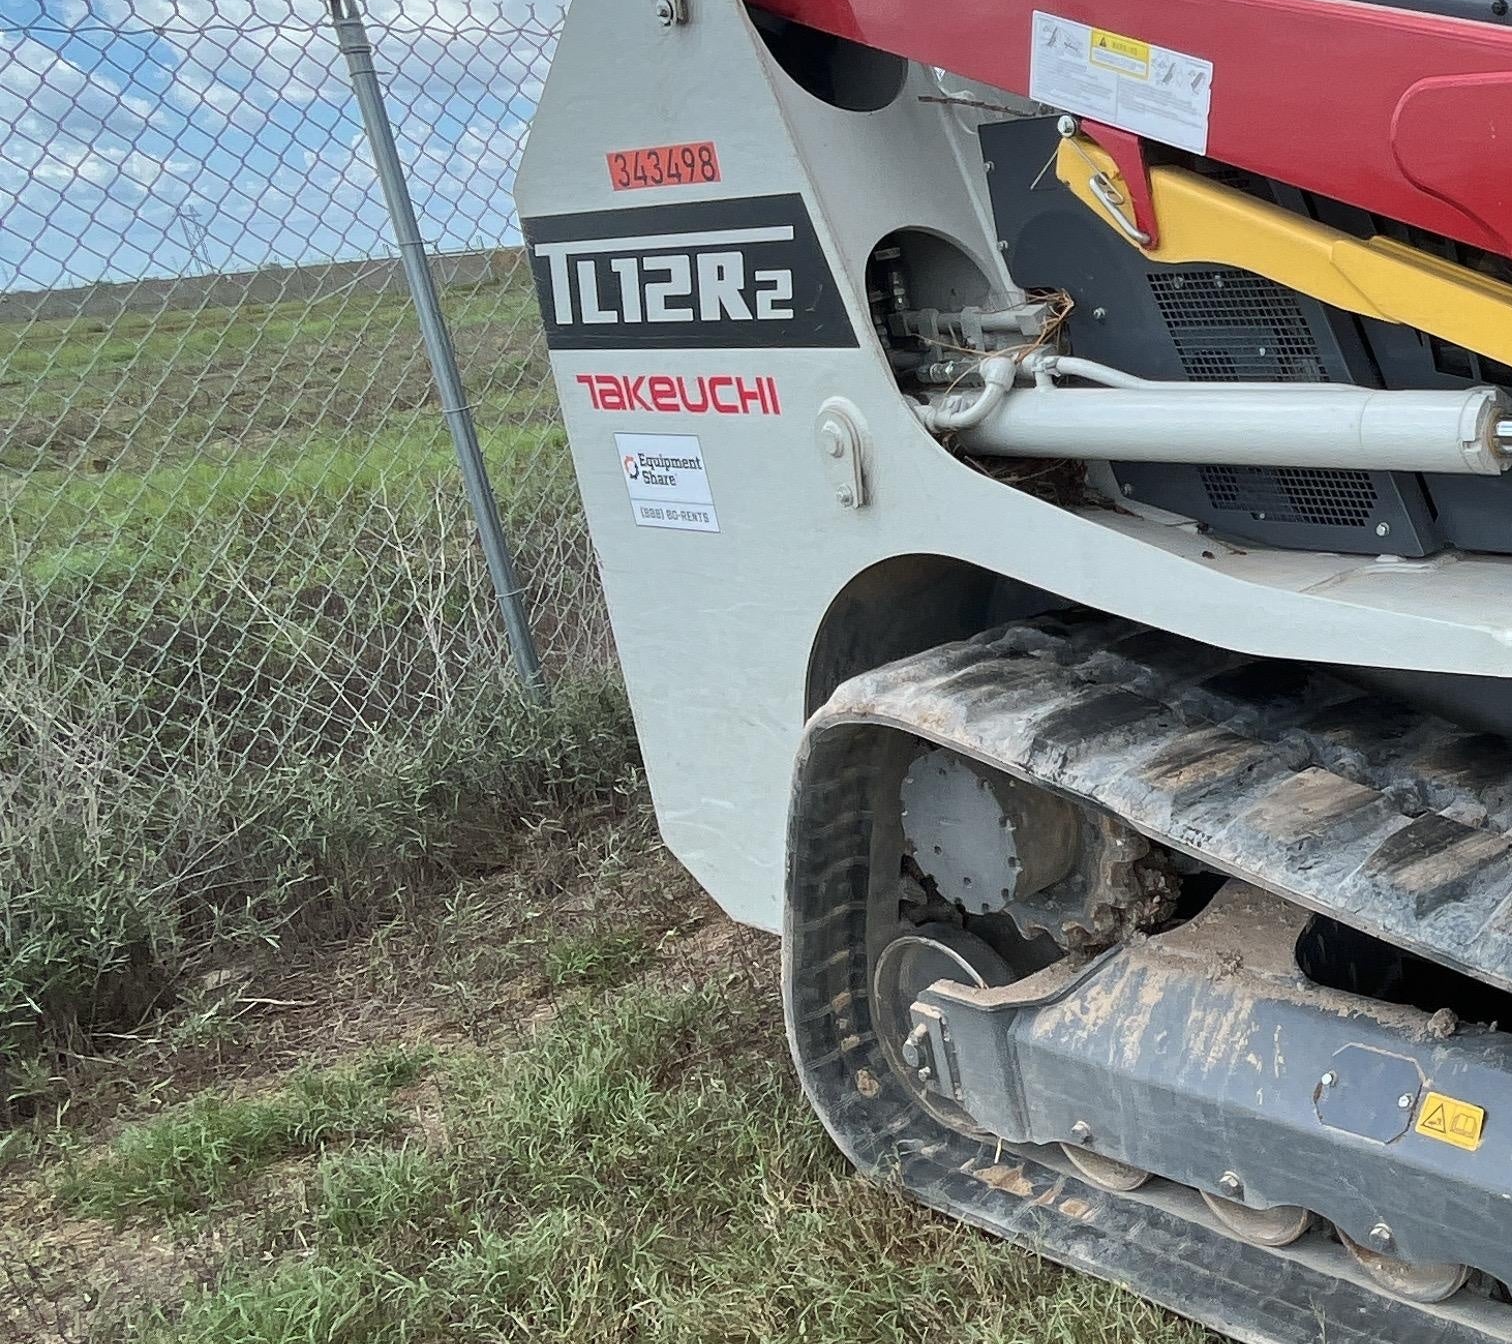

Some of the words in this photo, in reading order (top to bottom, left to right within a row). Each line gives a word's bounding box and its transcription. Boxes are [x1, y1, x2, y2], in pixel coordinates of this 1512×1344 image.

[615, 145, 715, 187] 343498
[535, 225, 794, 325] TL12R2
[576, 375, 781, 416] TAKEUCHI
[637, 453, 703, 471] Equipment
[641, 470, 677, 486] Share
